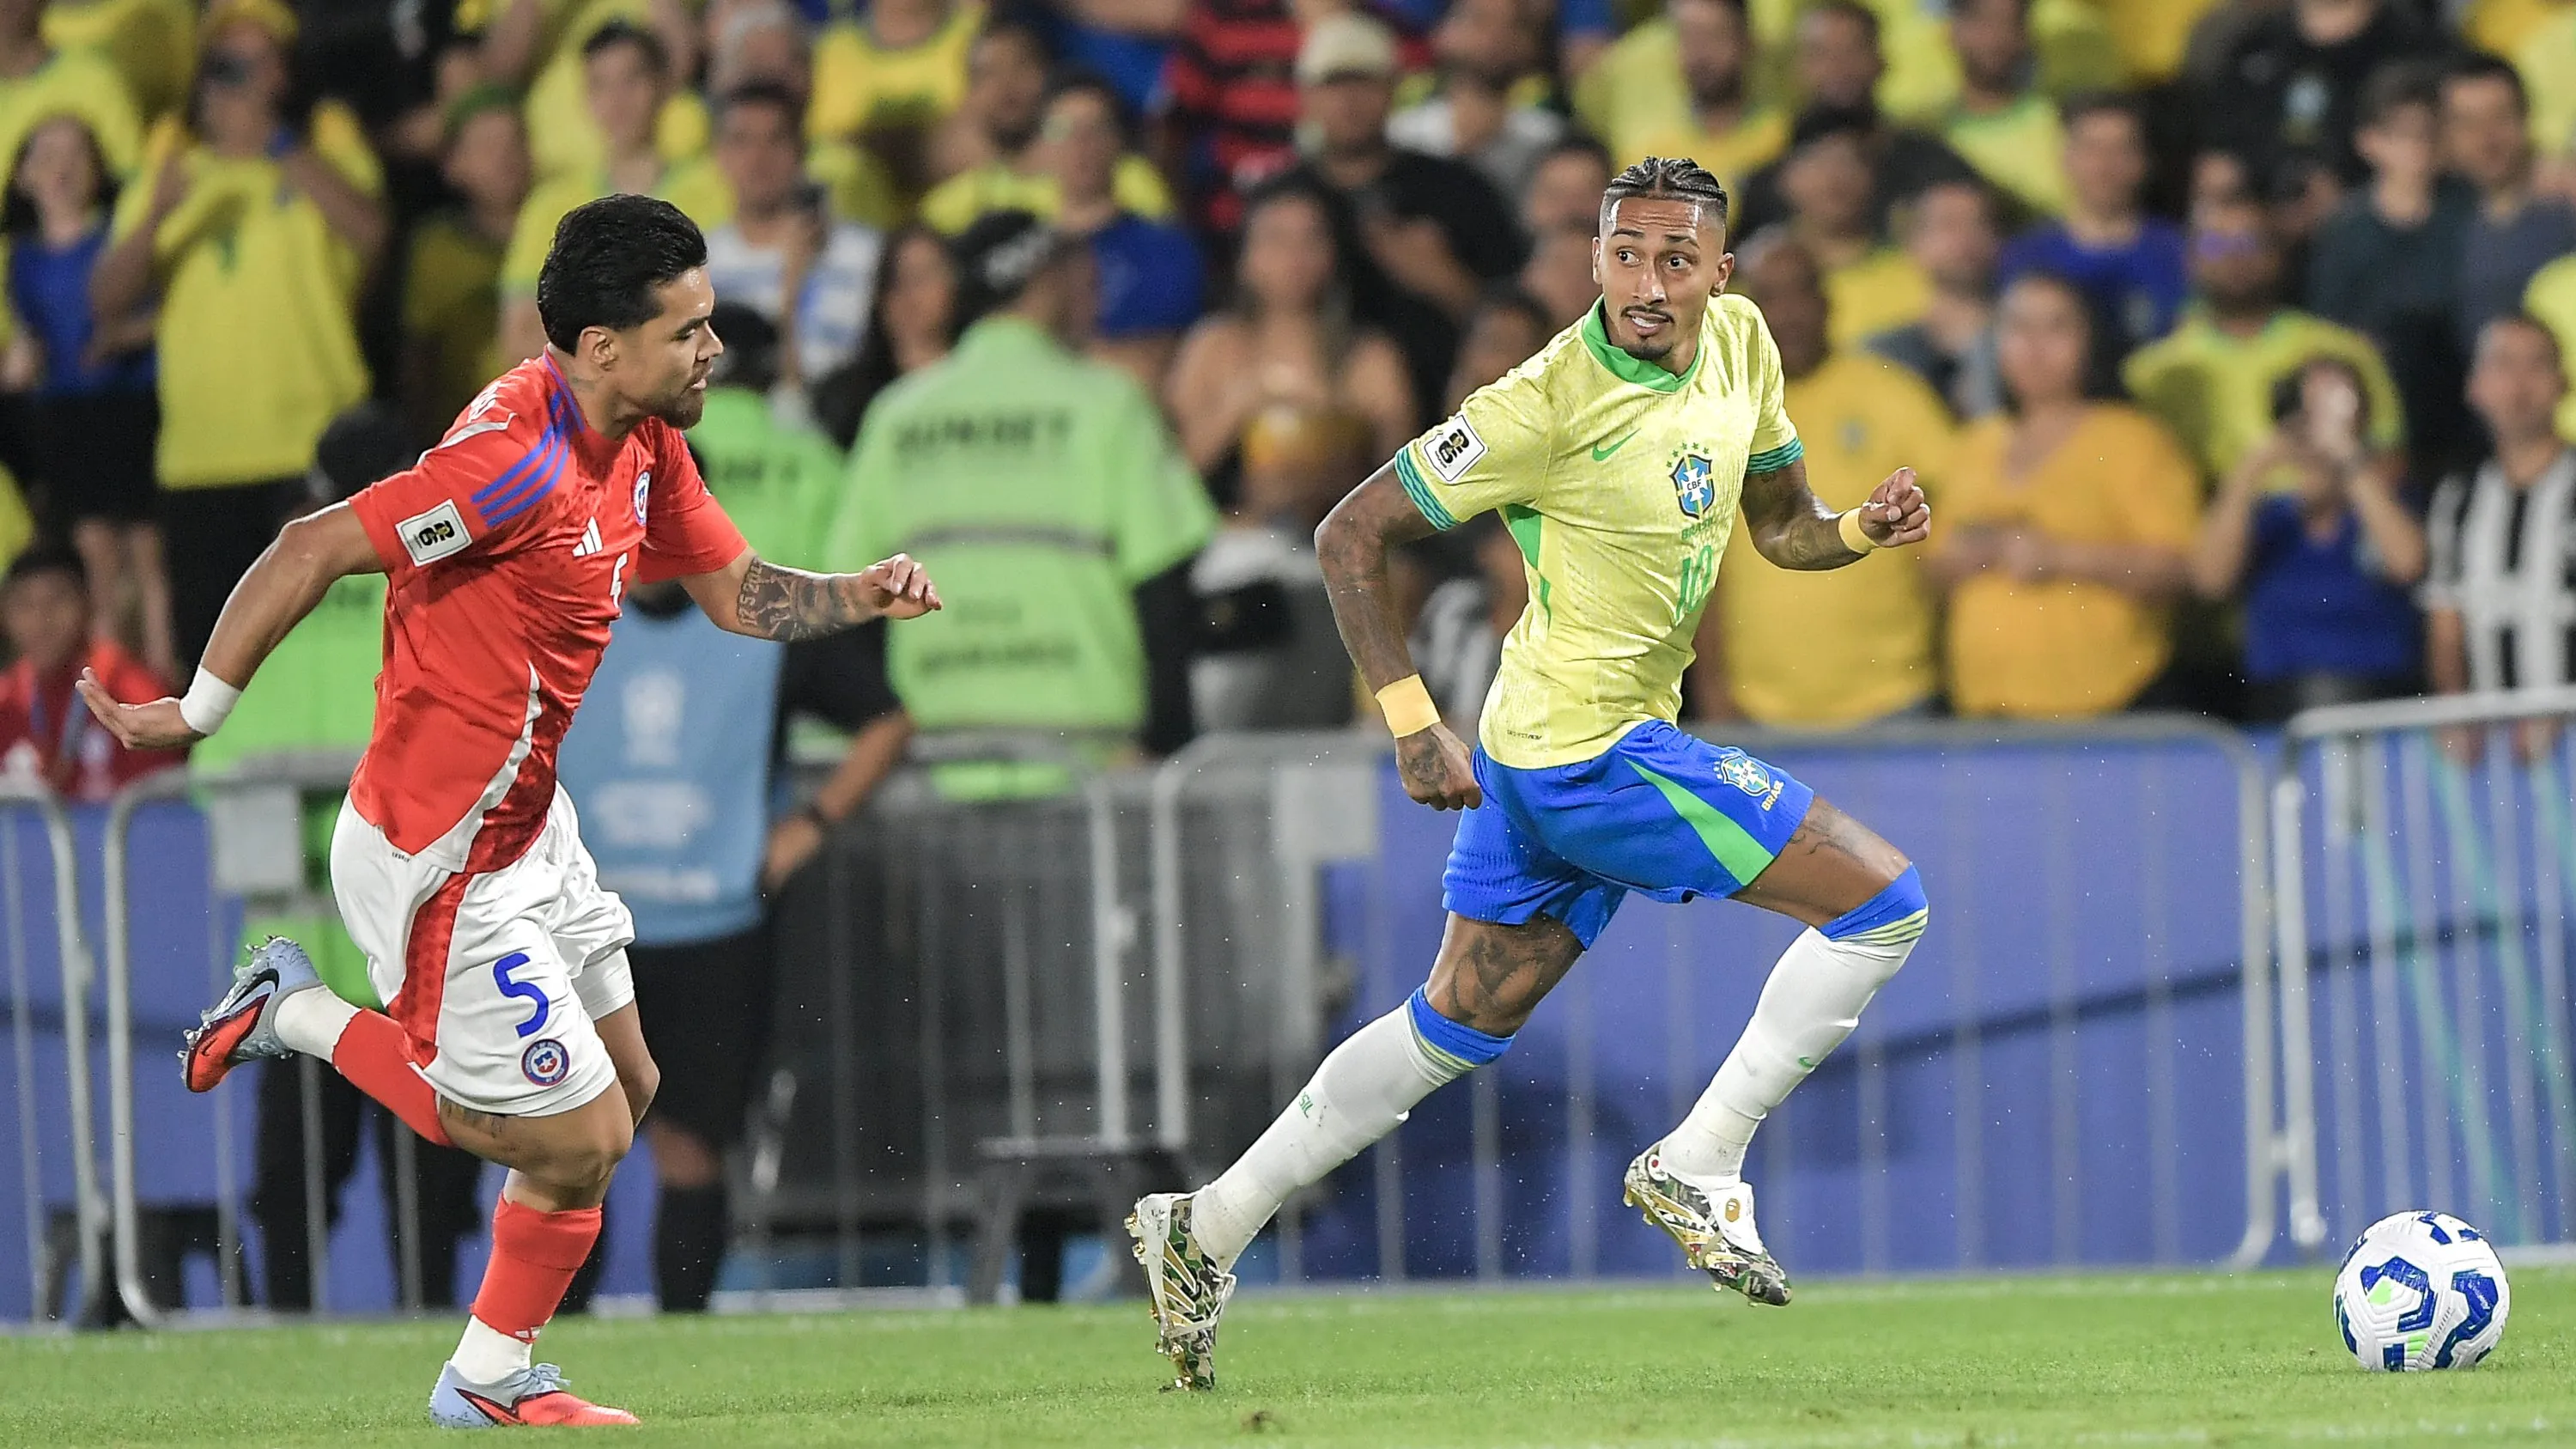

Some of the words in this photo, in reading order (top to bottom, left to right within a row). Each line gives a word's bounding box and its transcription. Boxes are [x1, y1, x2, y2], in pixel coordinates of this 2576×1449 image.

[1686, 478, 1703, 491] CBF
[1675, 545, 1713, 622] 10
[493, 953, 550, 1038] 5
[1298, 1091, 1314, 1118] SIL
